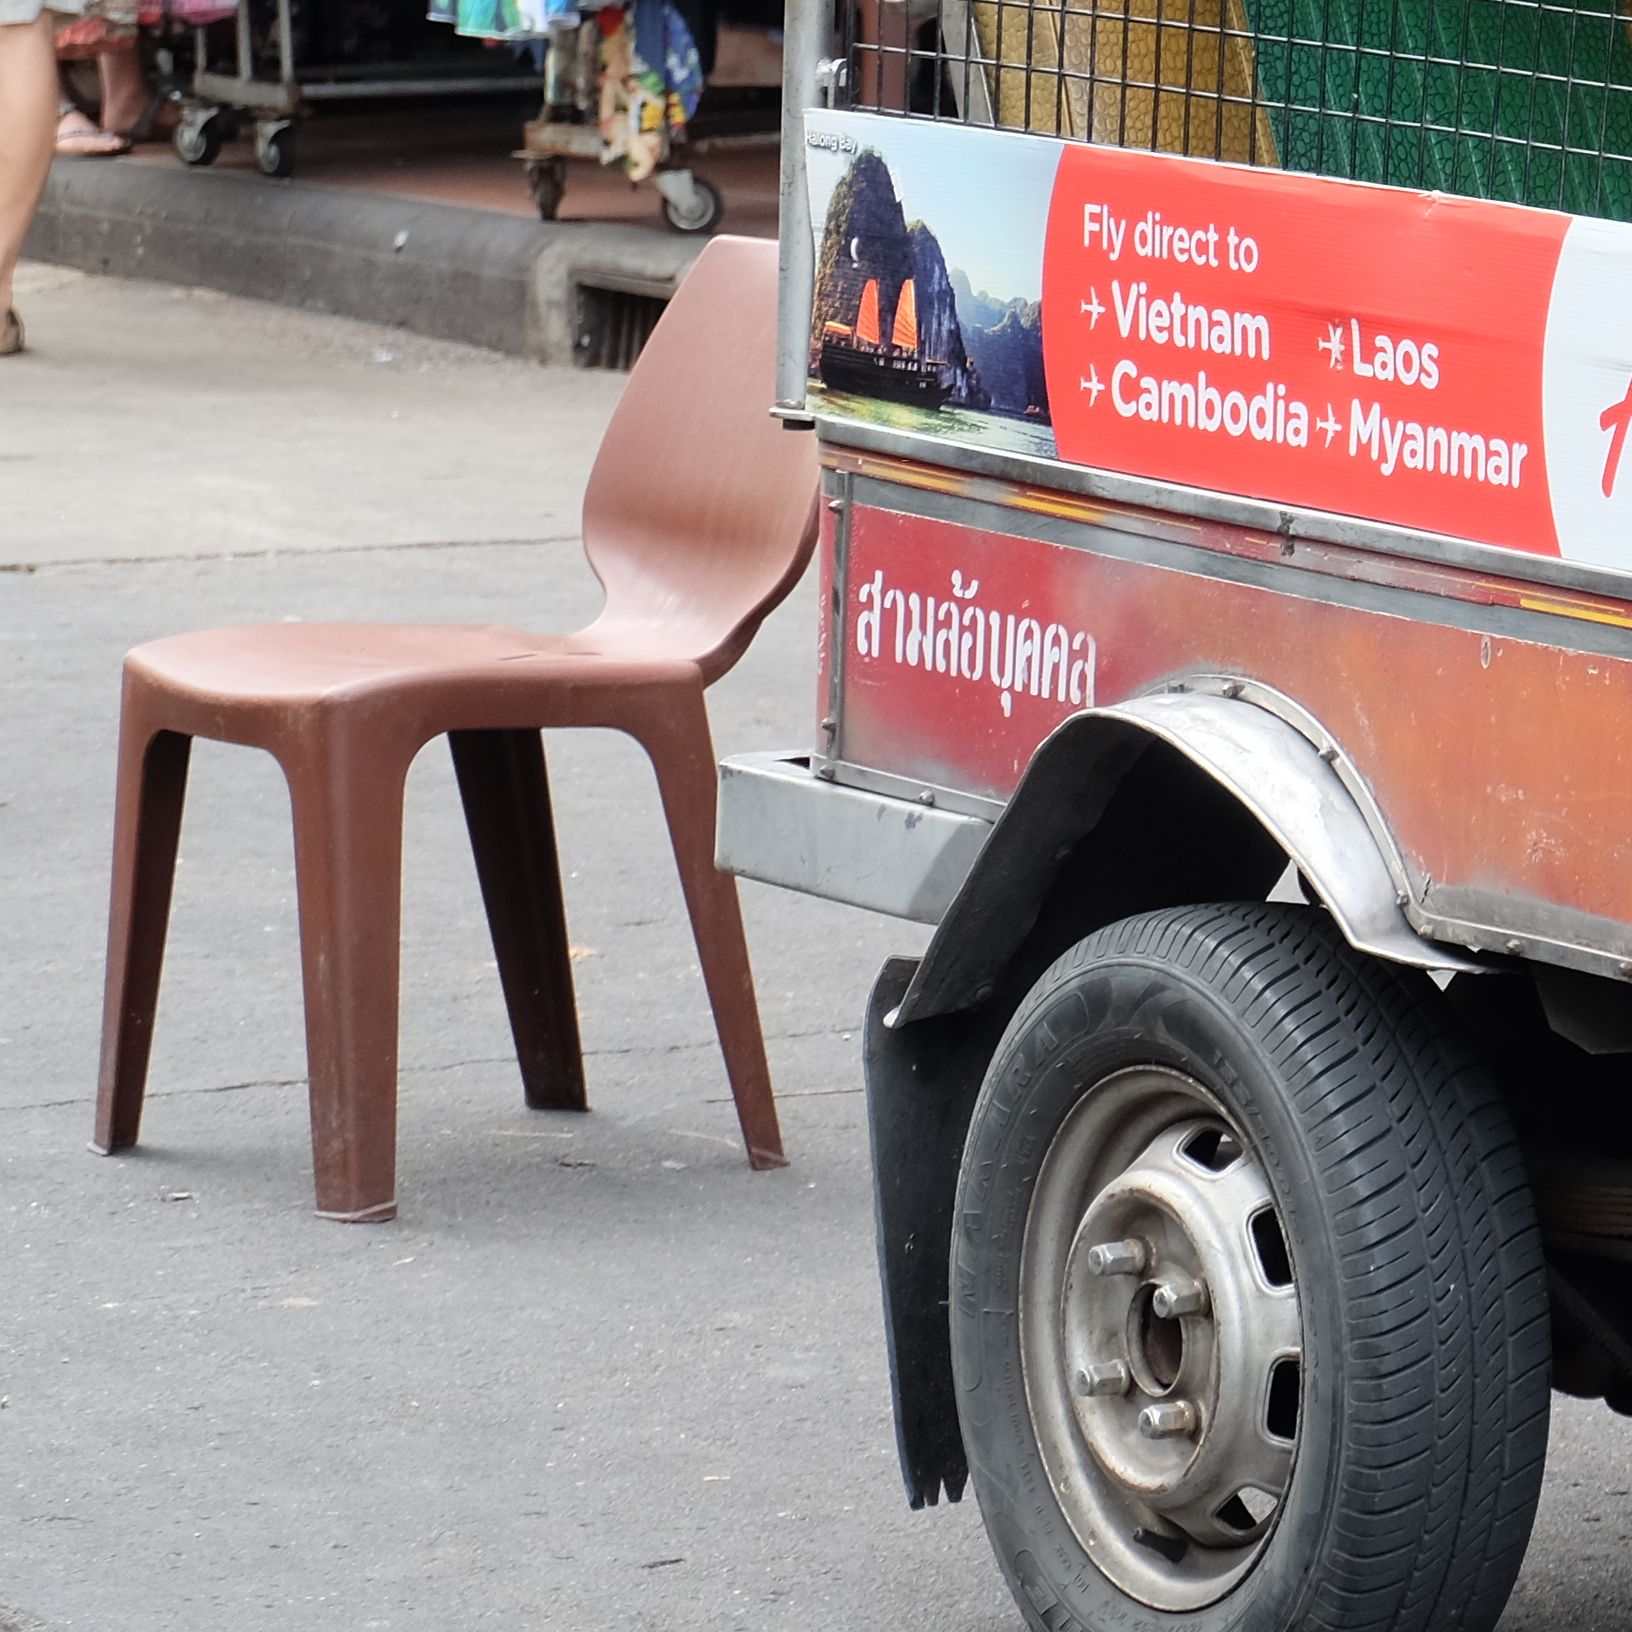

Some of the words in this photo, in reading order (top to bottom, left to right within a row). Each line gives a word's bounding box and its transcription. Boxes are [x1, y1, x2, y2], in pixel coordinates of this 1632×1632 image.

[1083, 202, 1126, 261] Fly
[1134, 210, 1219, 268] direct
[1226, 225, 1259, 273] to
[1111, 278, 1271, 361] Vietnam
[1350, 317, 1440, 390] Laos
[1110, 358, 1310, 448] Cambodia
[1348, 397, 1529, 489] Myanmar
[855, 569, 1097, 719] สามล้อบุคคล
